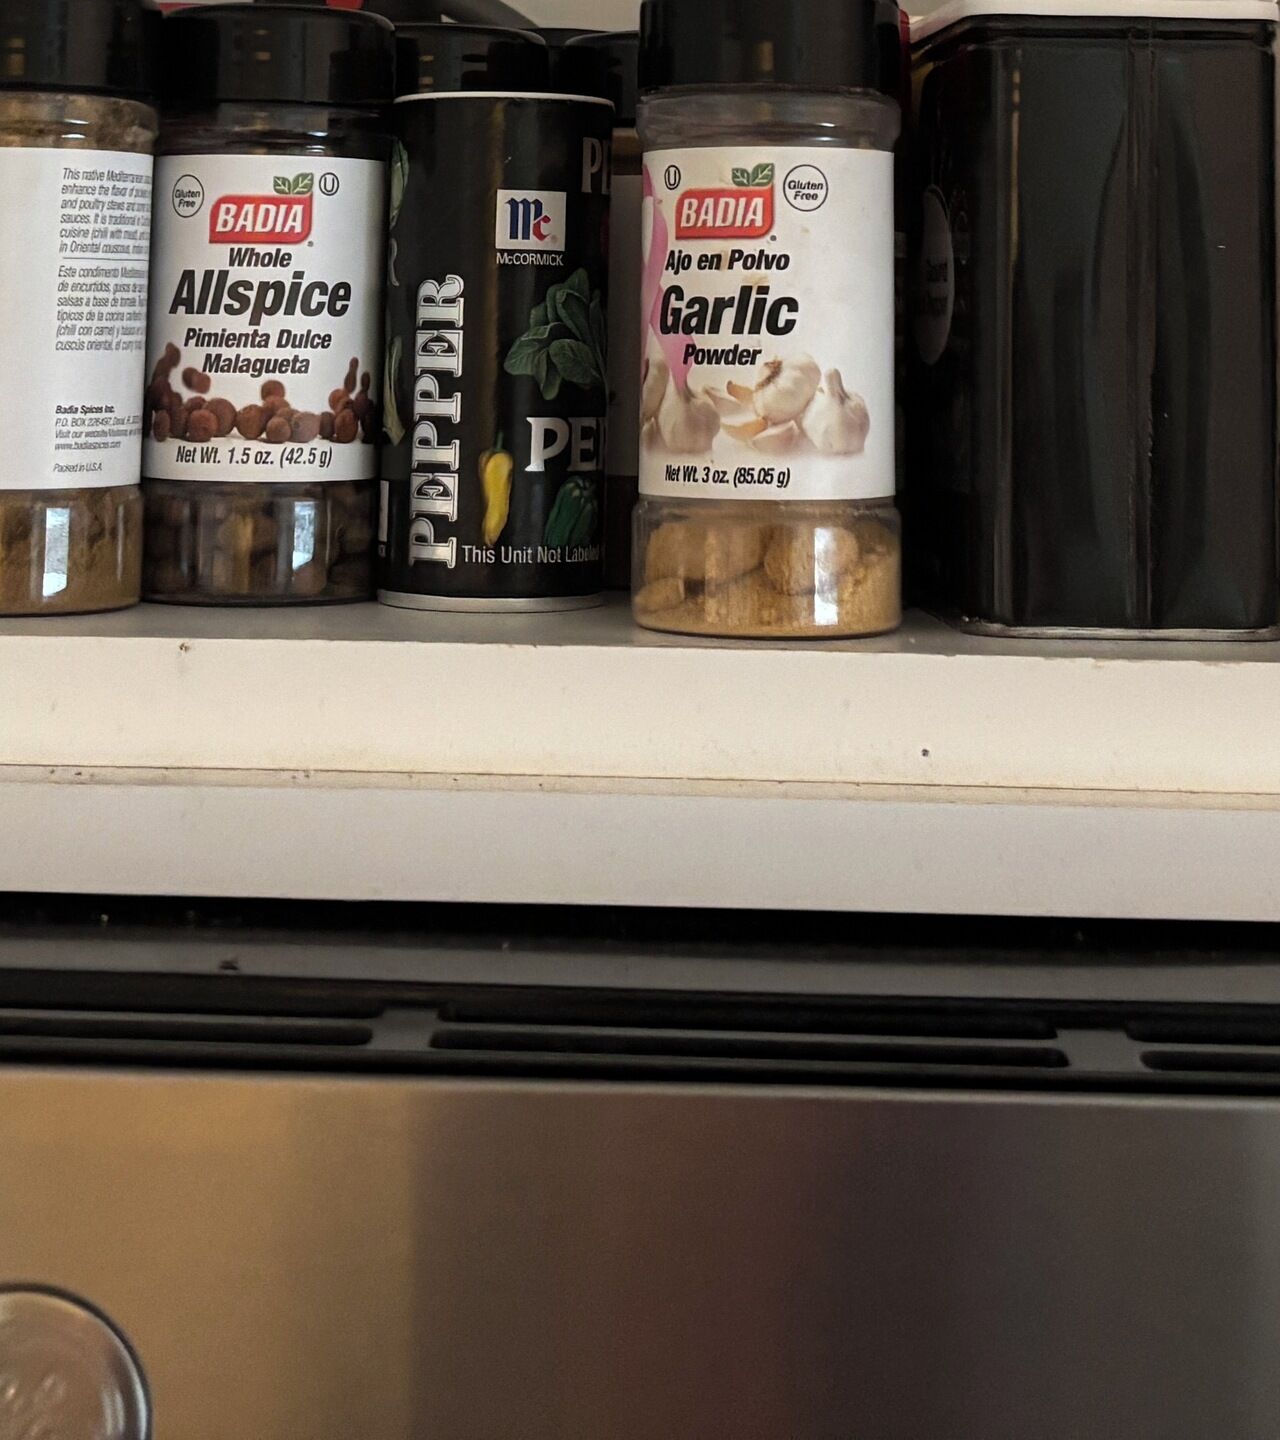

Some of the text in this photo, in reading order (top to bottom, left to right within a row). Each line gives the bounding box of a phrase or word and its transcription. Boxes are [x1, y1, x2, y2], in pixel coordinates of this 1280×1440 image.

[64, 168, 105, 180] This native
[62, 184, 109, 195] enhance the
[788, 181, 823, 191] Gluten
[175, 189, 200, 198] Gluten
[794, 191, 818, 201] Free
[61, 198, 78, 209] and
[79, 199, 106, 211] poultry
[178, 199, 195, 208] Free
[60, 214, 91, 224] sauces.
[216, 204, 303, 233] BADIA
[681, 198, 764, 228] BADIA
[60, 227, 89, 238] cuisine
[59, 241, 100, 253] in Oriental
[229, 248, 292, 267] Whole
[496, 252, 563, 266] McCORMICK
[665, 249, 790, 275] Ajo en Polvo
[58, 265, 119, 278] Este condimento
[58, 280, 69, 292] de
[57, 295, 110, 307] salsas base
[169, 269, 351, 325] Allspice
[86, 309, 95, 321] de
[660, 285, 799, 336] Garlic
[78, 326, 92, 335] con
[184, 328, 332, 349] Pimienta Dulce
[683, 344, 762, 366] Powder
[203, 354, 310, 377] Malagueta
[56, 405, 103, 415] Badia Spices
[71, 418, 85, 427] BOX
[409, 275, 465, 569] PEPPER
[56, 430, 71, 438] Visit
[176, 446, 332, 468] Net Wt. 1.5 oz. (42.5 g)
[665, 465, 790, 487] Net Wt. 3 oz. (85.05 g)
[462, 545, 495, 563] This
[501, 546, 532, 563] Unit
[538, 546, 561, 563] Not
